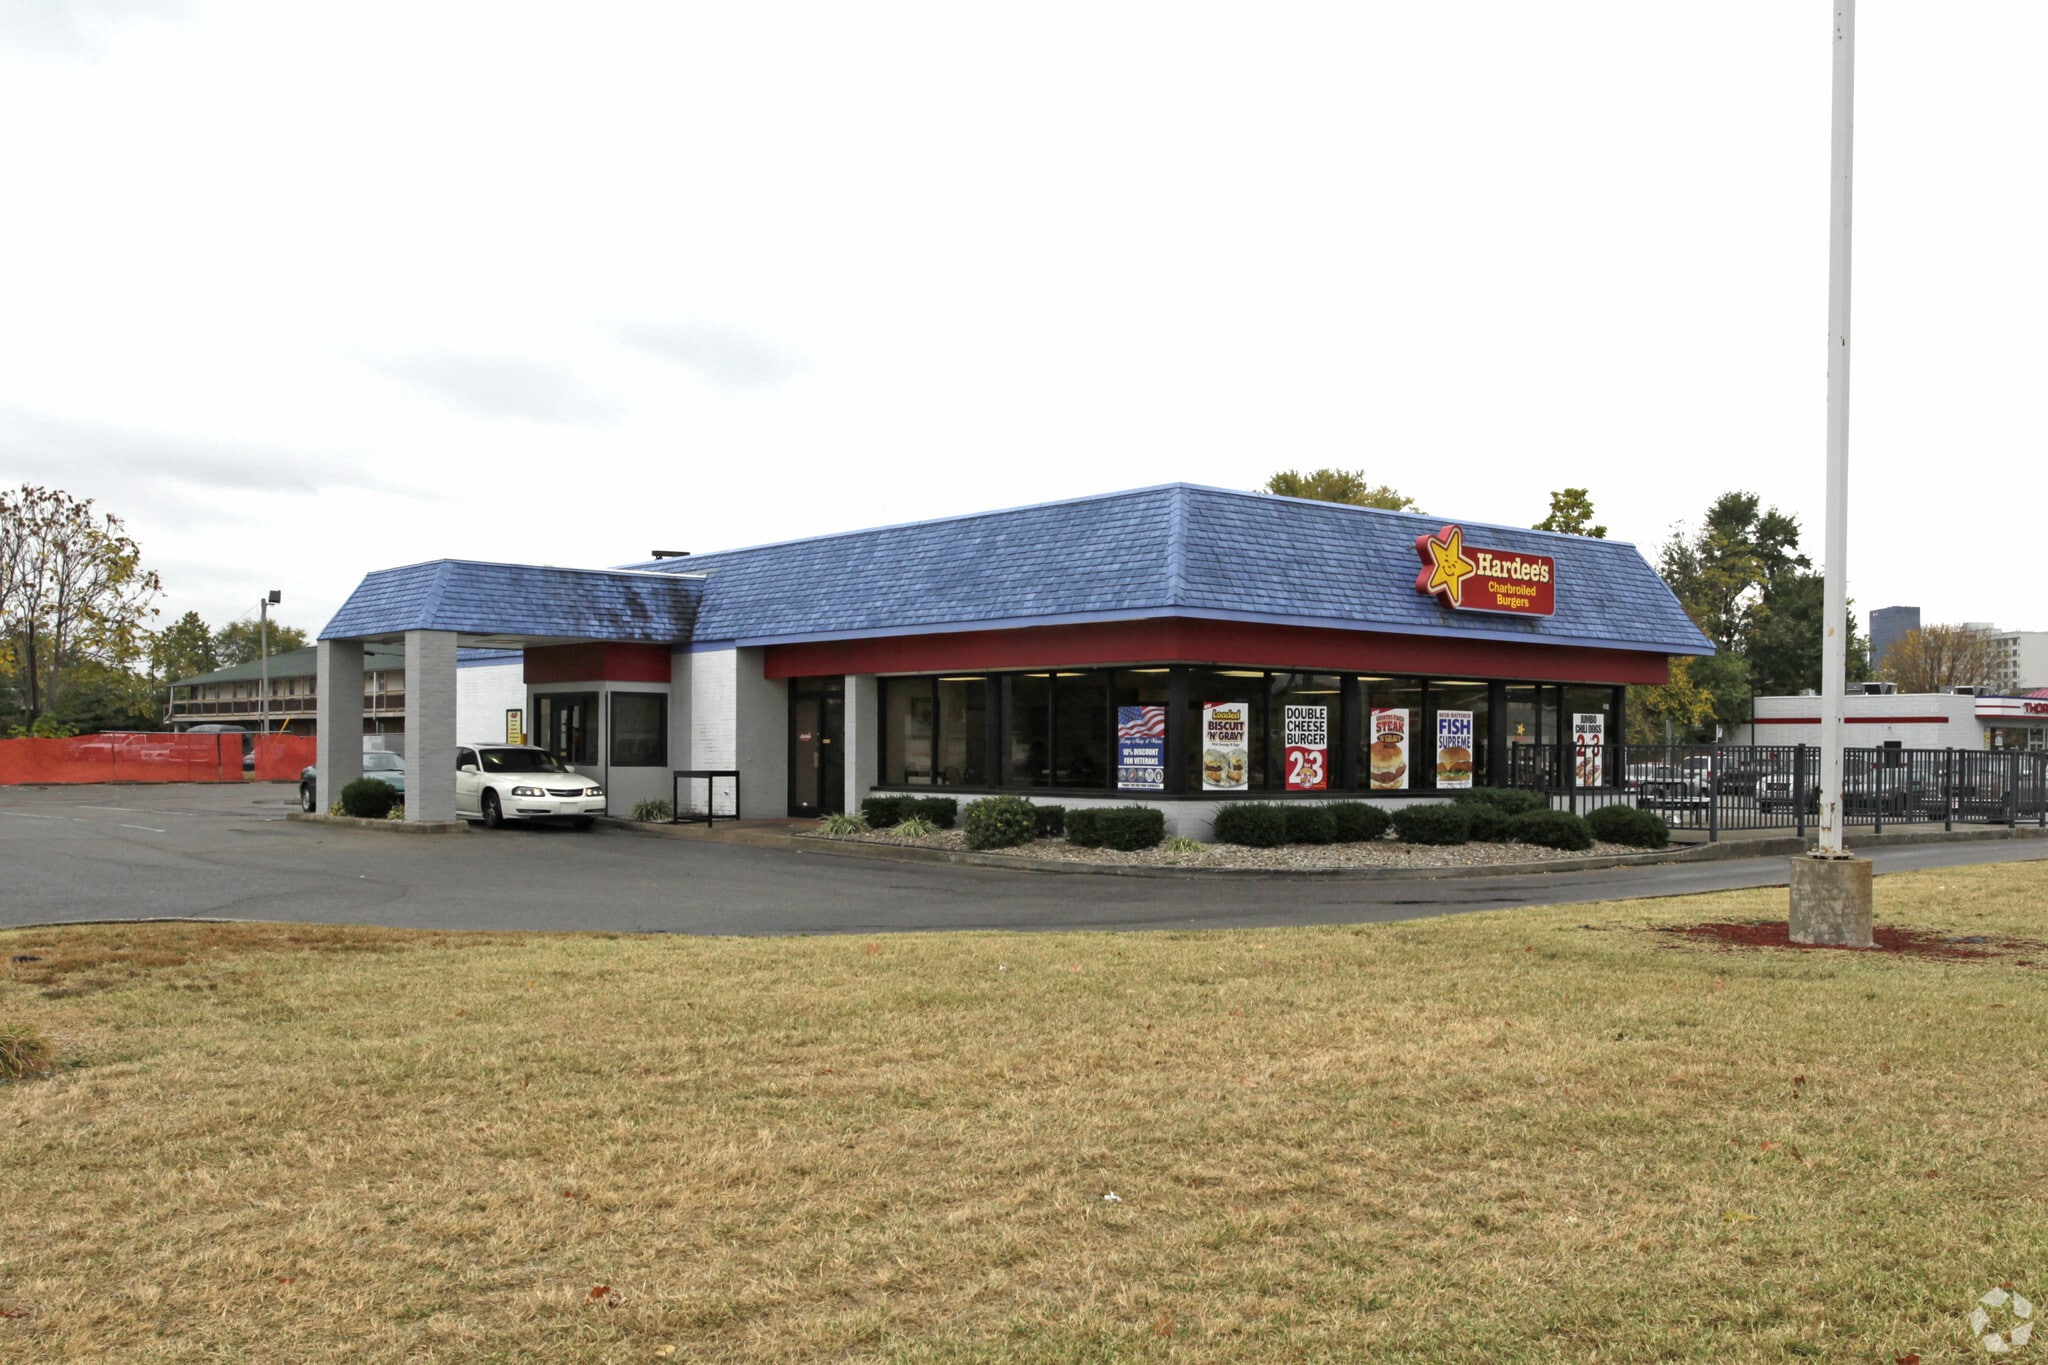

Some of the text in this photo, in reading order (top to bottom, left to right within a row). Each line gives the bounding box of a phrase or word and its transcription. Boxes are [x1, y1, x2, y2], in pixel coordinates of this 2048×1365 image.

[1477, 553, 1549, 583] Hardee's
[1488, 581, 1536, 596] Charbroiled
[1497, 594, 1529, 608] Burgers
[1212, 709, 1241, 720] Loaded
[1286, 707, 1325, 720] DOUBLE
[1580, 715, 1597, 723] JUMBO
[1208, 721, 1244, 731] BISCUIT
[1287, 720, 1325, 732] CHEESE
[1376, 721, 1404, 734] STEAK
[1439, 719, 1471, 735] FISH
[1575, 724, 1601, 733] CHILI DOGS
[1218, 731, 1244, 741] GRAVY
[1287, 733, 1325, 745] BURGER
[1439, 736, 1471, 748] SUPREME
[1133, 748, 1158, 756] DISCOUNT
[1133, 757, 1158, 765] VETERANS
[1288, 751, 1304, 783] 2
